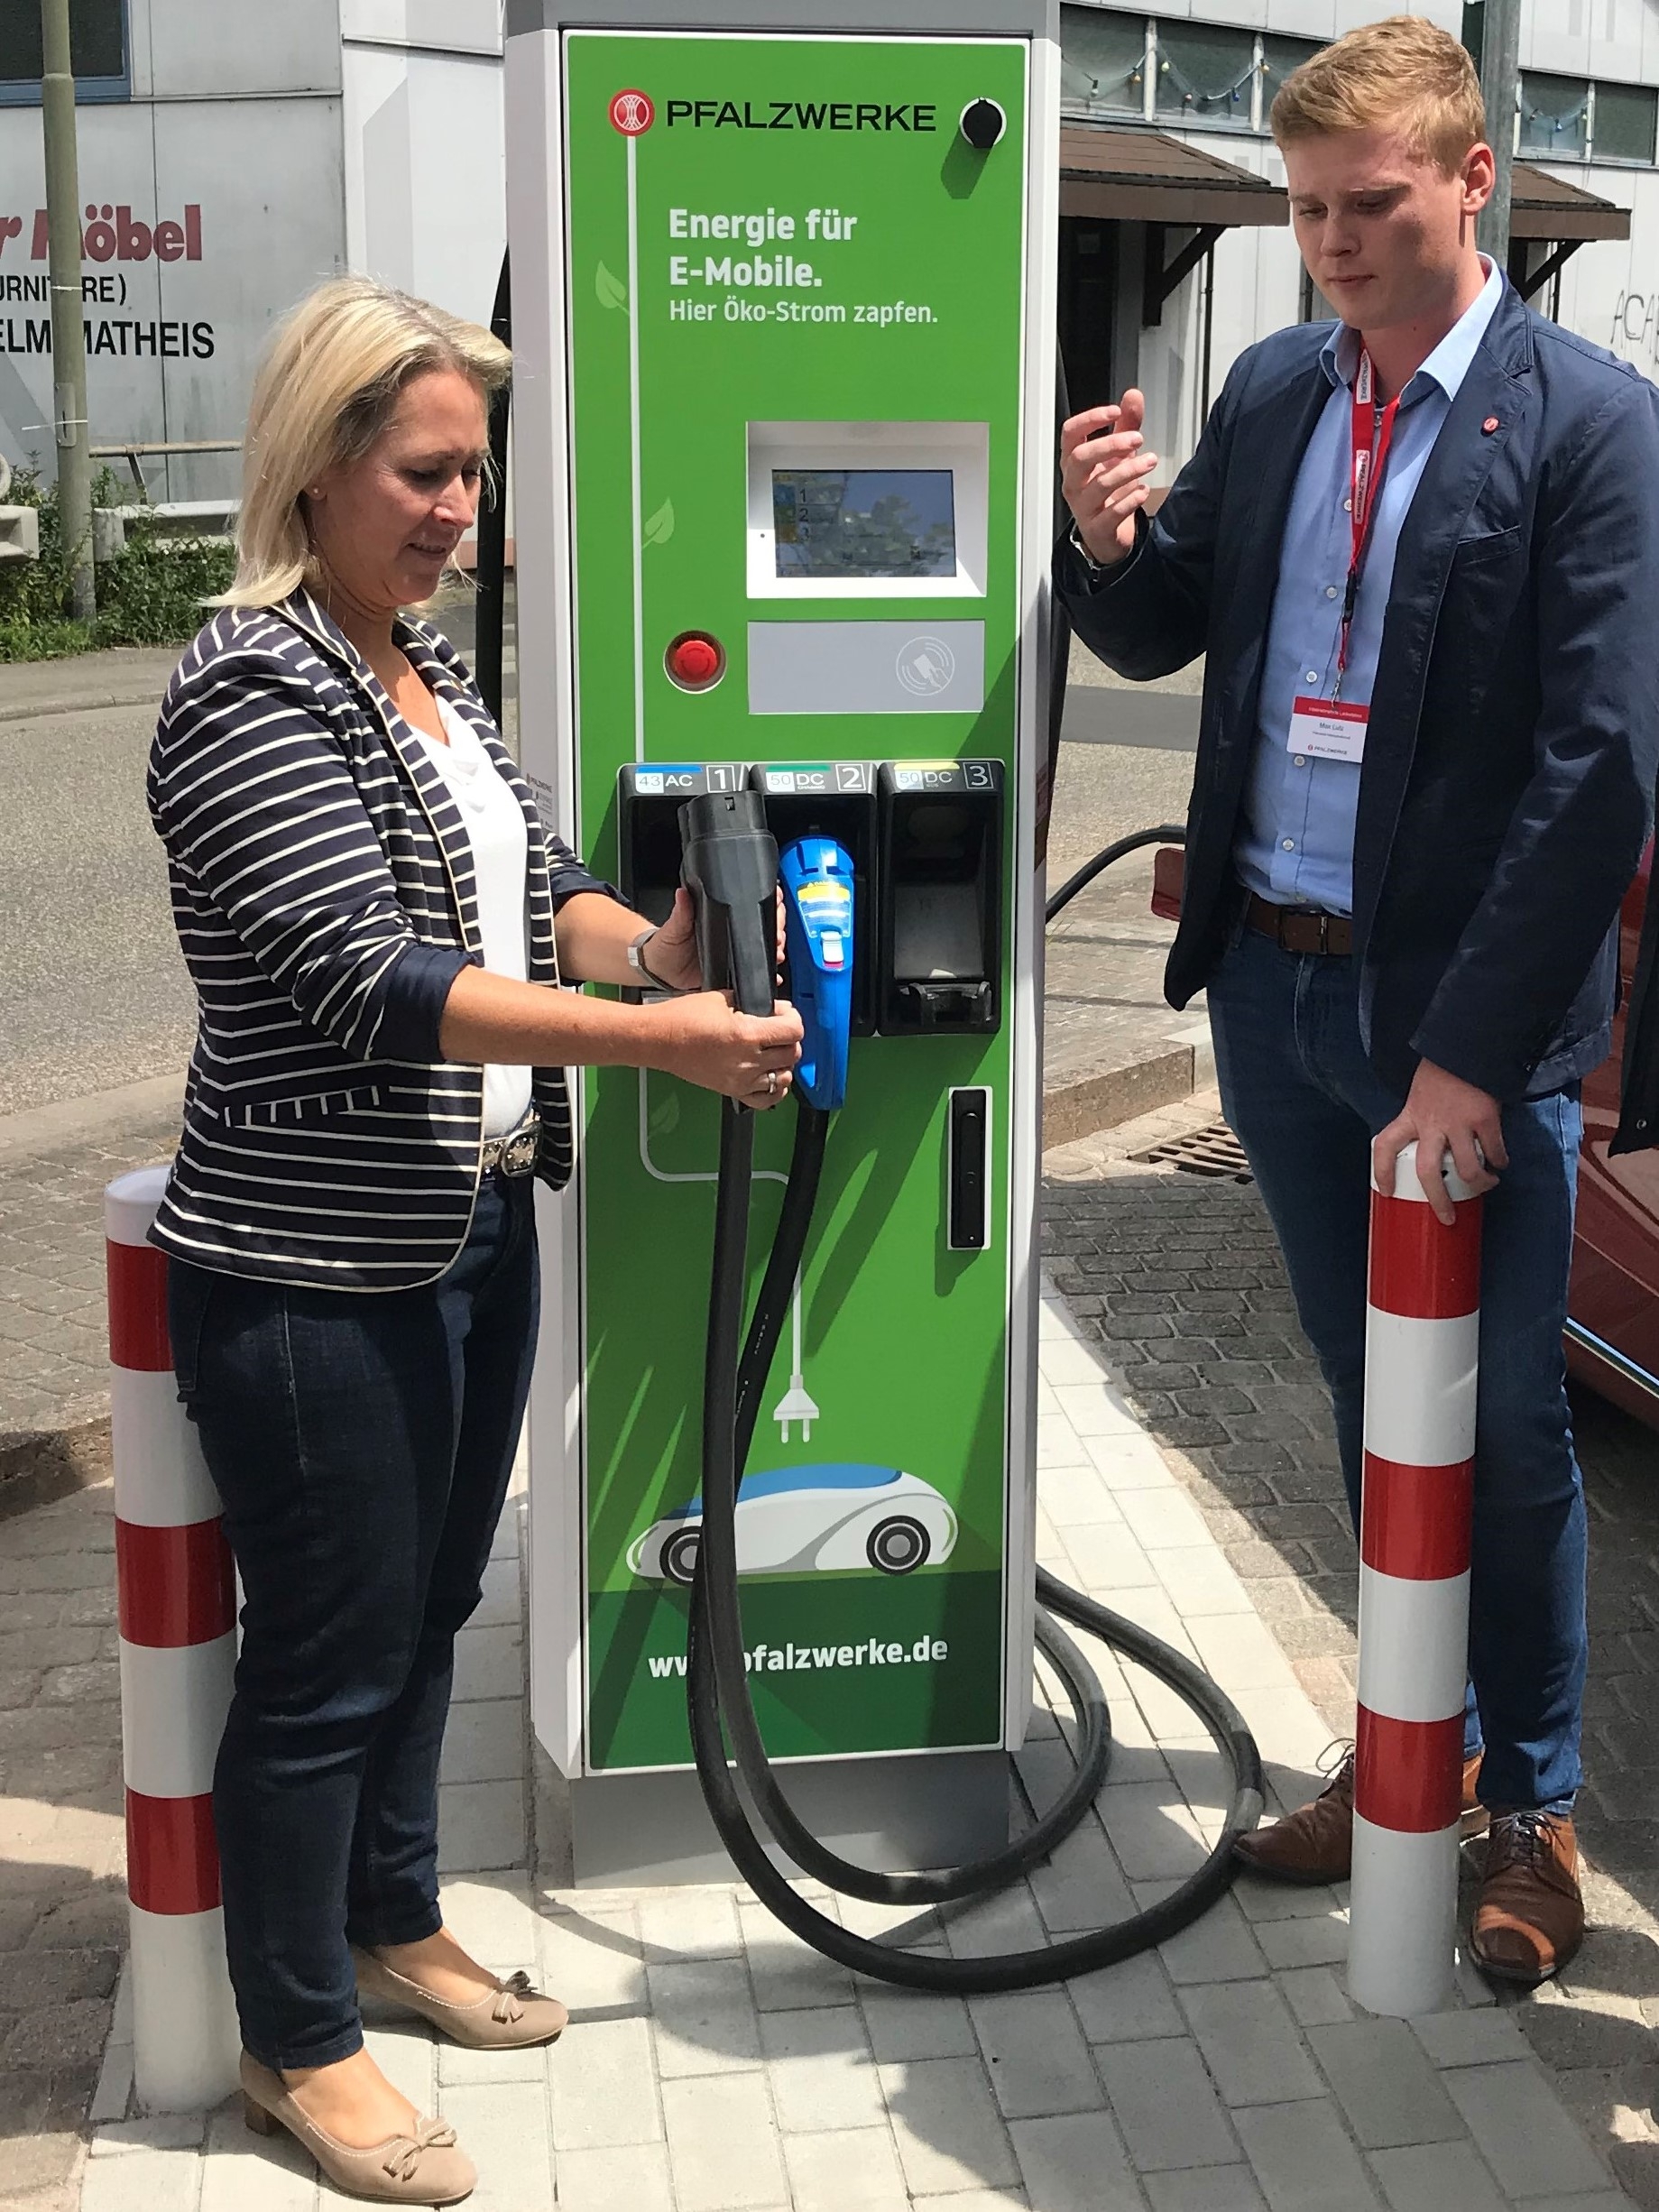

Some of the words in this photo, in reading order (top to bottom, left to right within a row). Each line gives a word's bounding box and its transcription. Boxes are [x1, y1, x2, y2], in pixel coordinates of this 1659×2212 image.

[667, 100, 936, 132] PFALZWERKE
[669, 207, 795, 247] Energie
[806, 208, 858, 240] für
[669, 255, 823, 288] E-Mobile.
[0, 273, 126, 305] RNIRE)
[669, 299, 717, 322] Hier
[724, 295, 846, 324] Öko-Strom
[853, 300, 938, 327] zapfen.
[0, 318, 52, 354] LM
[1610, 290, 1659, 364] ACA
[799, 488, 806, 502] 1
[799, 508, 809, 522] 2
[639, 775, 660, 787] 43
[665, 774, 693, 787] AC
[714, 769, 726, 790] 1
[770, 774, 791, 786] 50
[796, 773, 825, 786] DC
[843, 767, 862, 788] 2
[899, 772, 920, 784] 50
[925, 771, 952, 783] DC
[969, 766, 989, 786] 3
